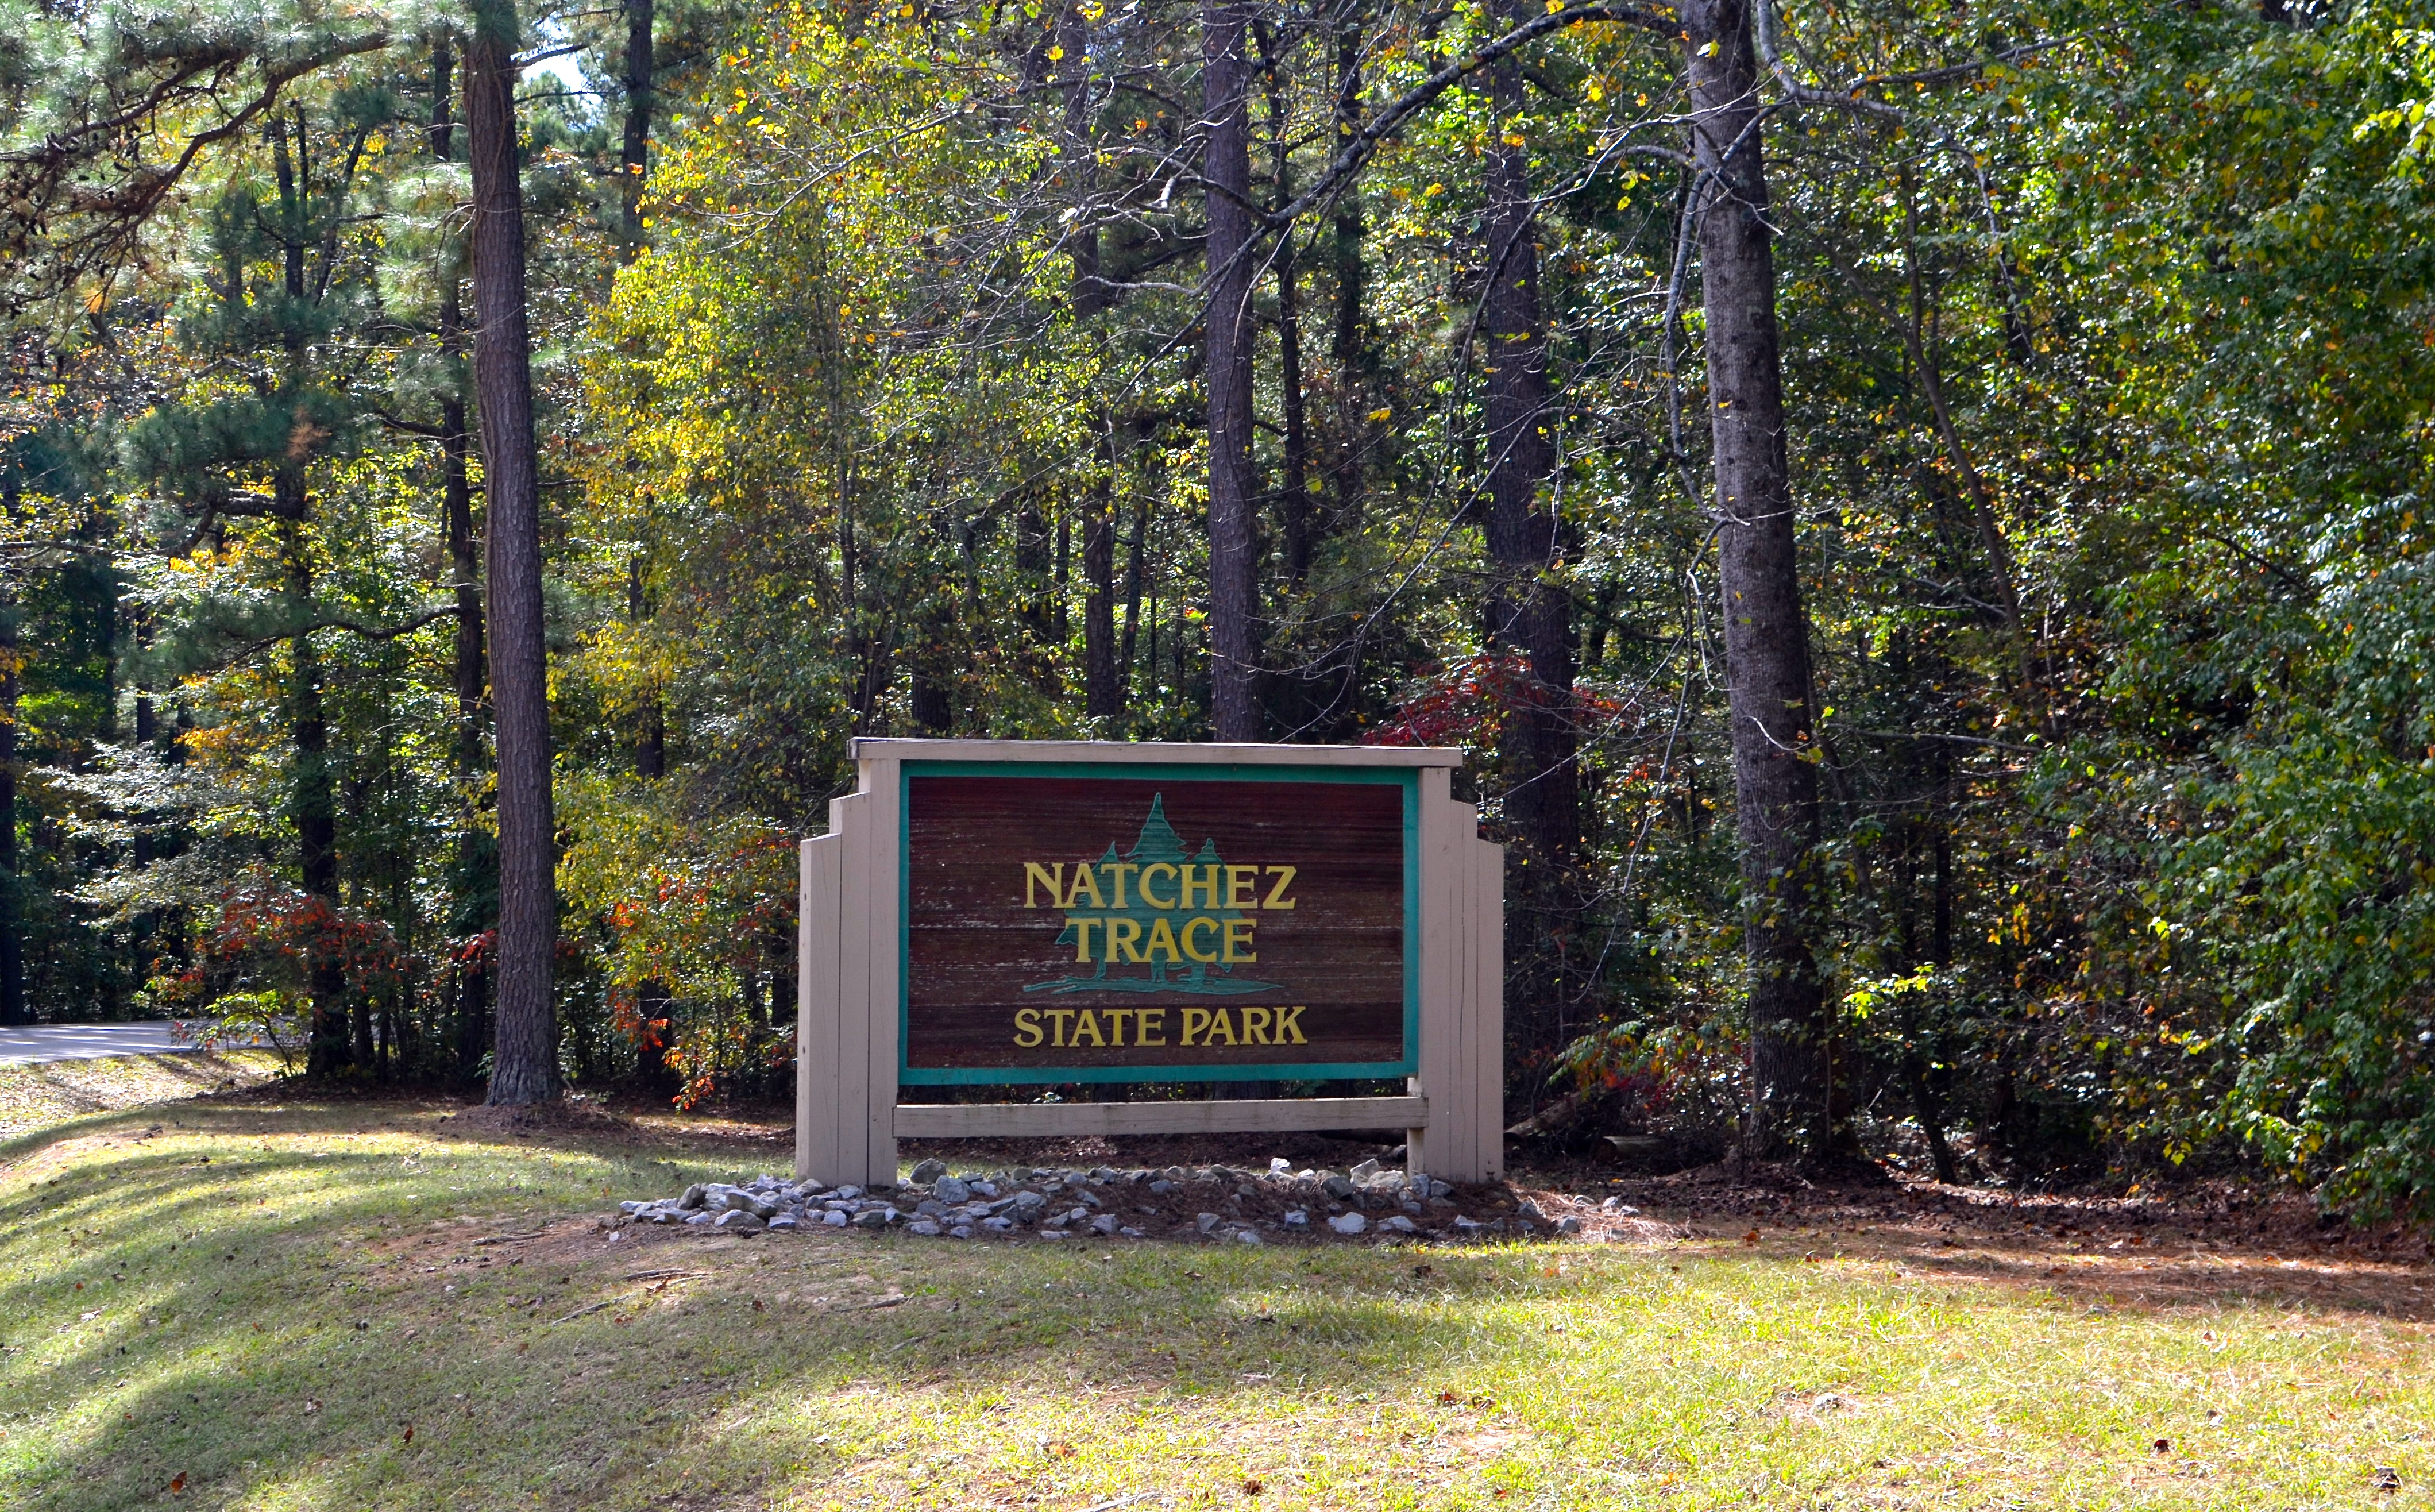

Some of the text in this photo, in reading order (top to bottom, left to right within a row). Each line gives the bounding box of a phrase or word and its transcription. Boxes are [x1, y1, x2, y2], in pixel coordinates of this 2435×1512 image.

[1024, 862, 1296, 909] NATCHEZ
[1064, 917, 1257, 962] TRACE
[1013, 1006, 1307, 1047] STATE PARK
